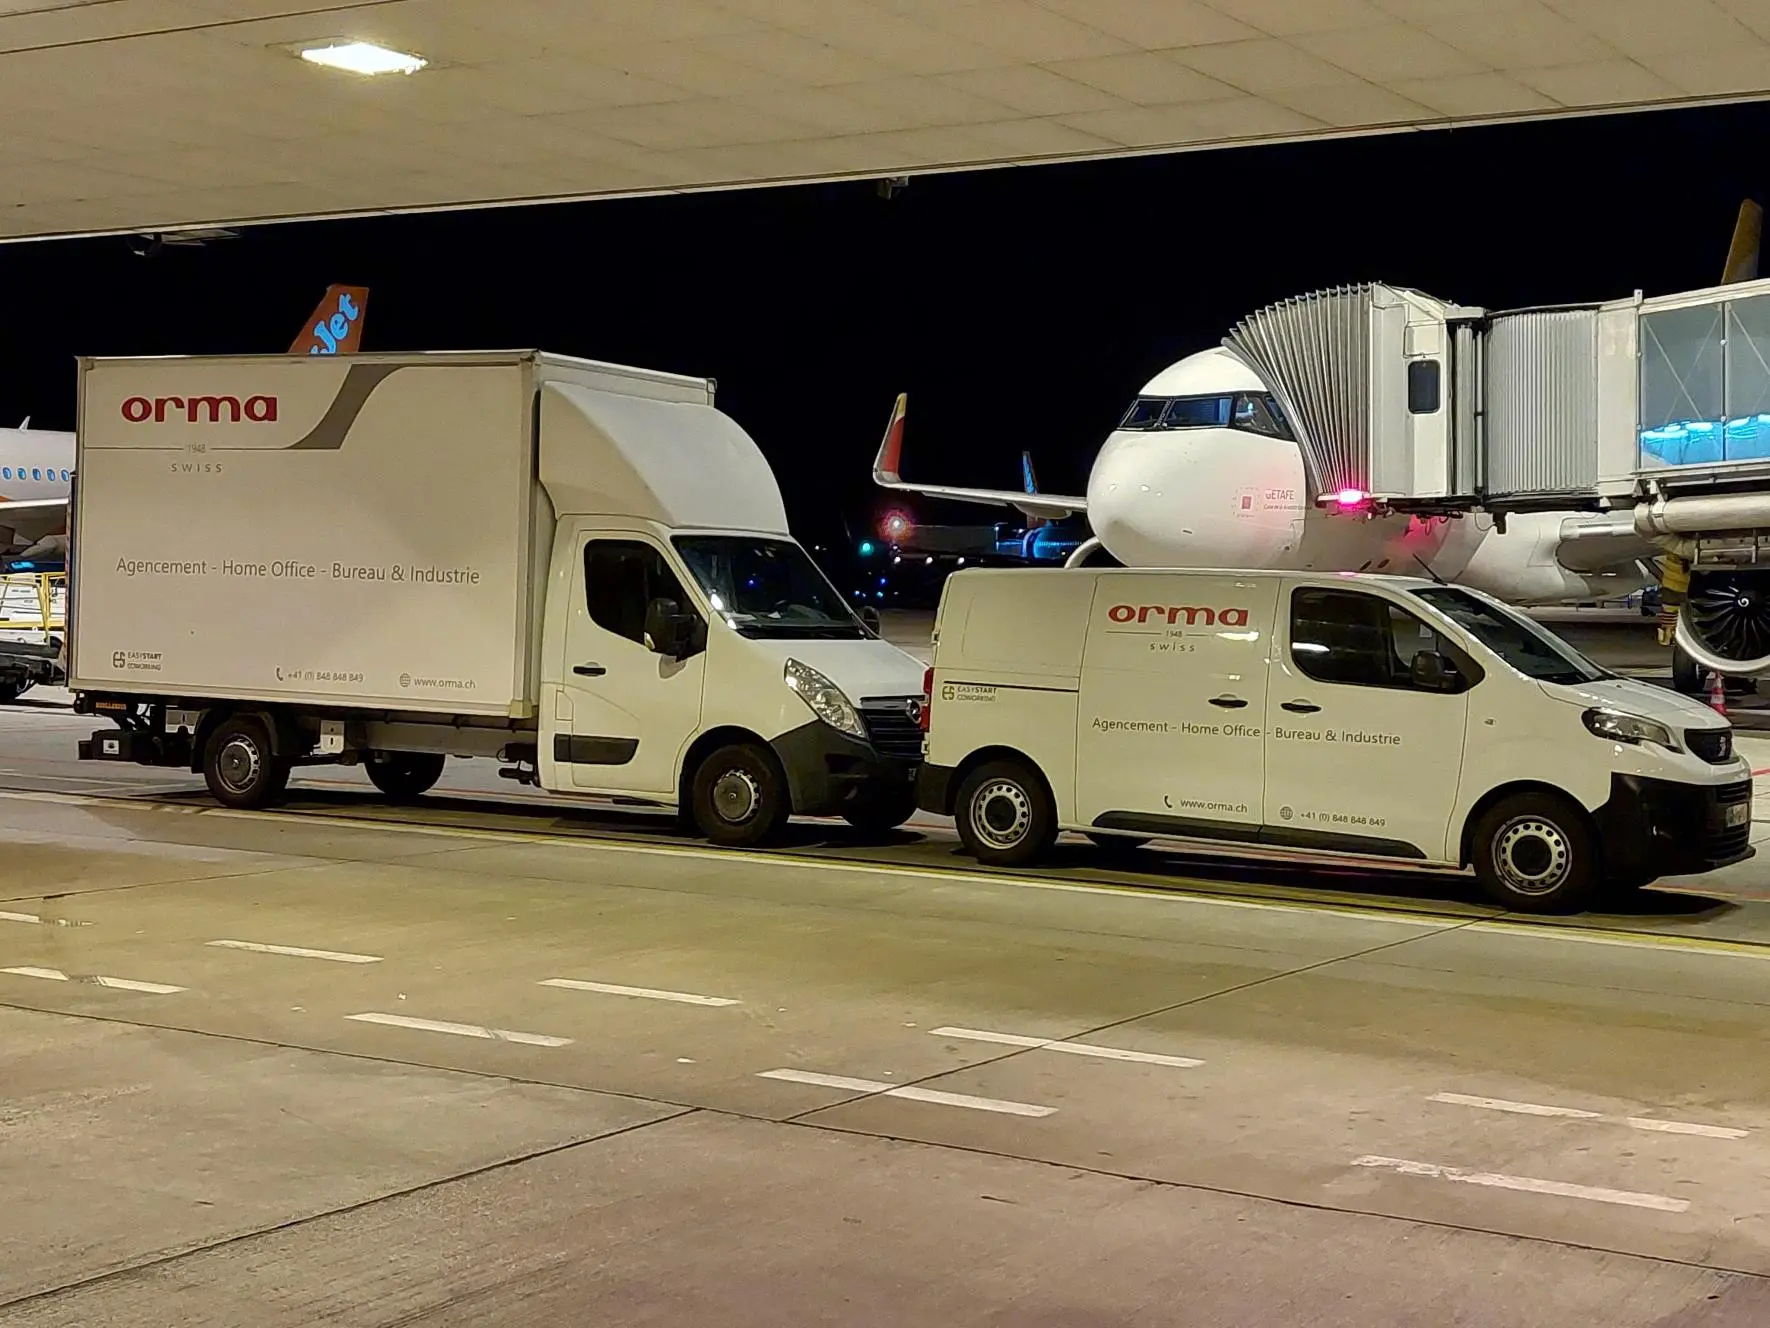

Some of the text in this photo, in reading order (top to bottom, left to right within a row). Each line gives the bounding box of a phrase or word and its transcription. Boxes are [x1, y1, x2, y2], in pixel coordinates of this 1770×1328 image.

[121, 395, 278, 422] orma
[116, 557, 207, 577] Agencement
[222, 559, 266, 576] Home
[271, 560, 316, 577] Office
[332, 563, 385, 580] Bureau
[391, 565, 404, 582] &
[410, 565, 480, 585] Industrie
[1108, 605, 1249, 627] orma
[1166, 630, 1182, 638] 1948
[316, 671, 331, 681] 848
[333, 672, 347, 682] 848
[348, 673, 364, 683] 849
[413, 677, 476, 690] www.orma.ch
[1092, 717, 1168, 732] Agencement
[1181, 722, 1219, 735] Home
[1223, 724, 1261, 737] Office
[1275, 727, 1320, 741] Bureau
[1325, 729, 1337, 742] &
[1341, 731, 1401, 745] Industrie
[1179, 797, 1248, 814] www.orma.ch
[1300, 811, 1386, 827] +41 (0) 848 848 849
